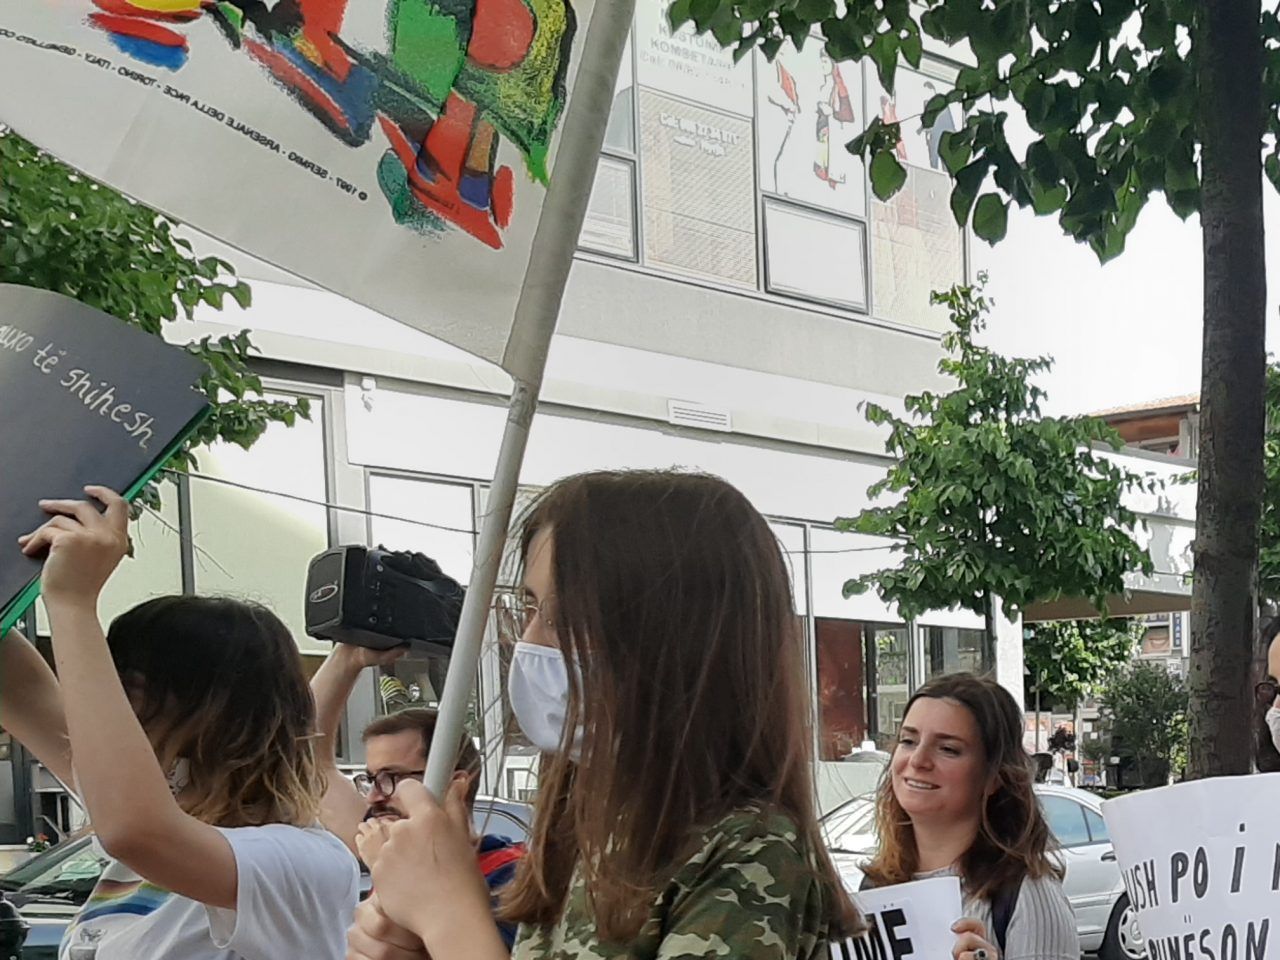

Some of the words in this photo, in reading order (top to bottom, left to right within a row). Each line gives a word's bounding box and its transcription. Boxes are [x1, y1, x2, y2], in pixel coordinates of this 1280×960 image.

[60, 369, 155, 449] shihesh
[1122, 858, 1159, 913] USH
[1171, 845, 1209, 904] PO
